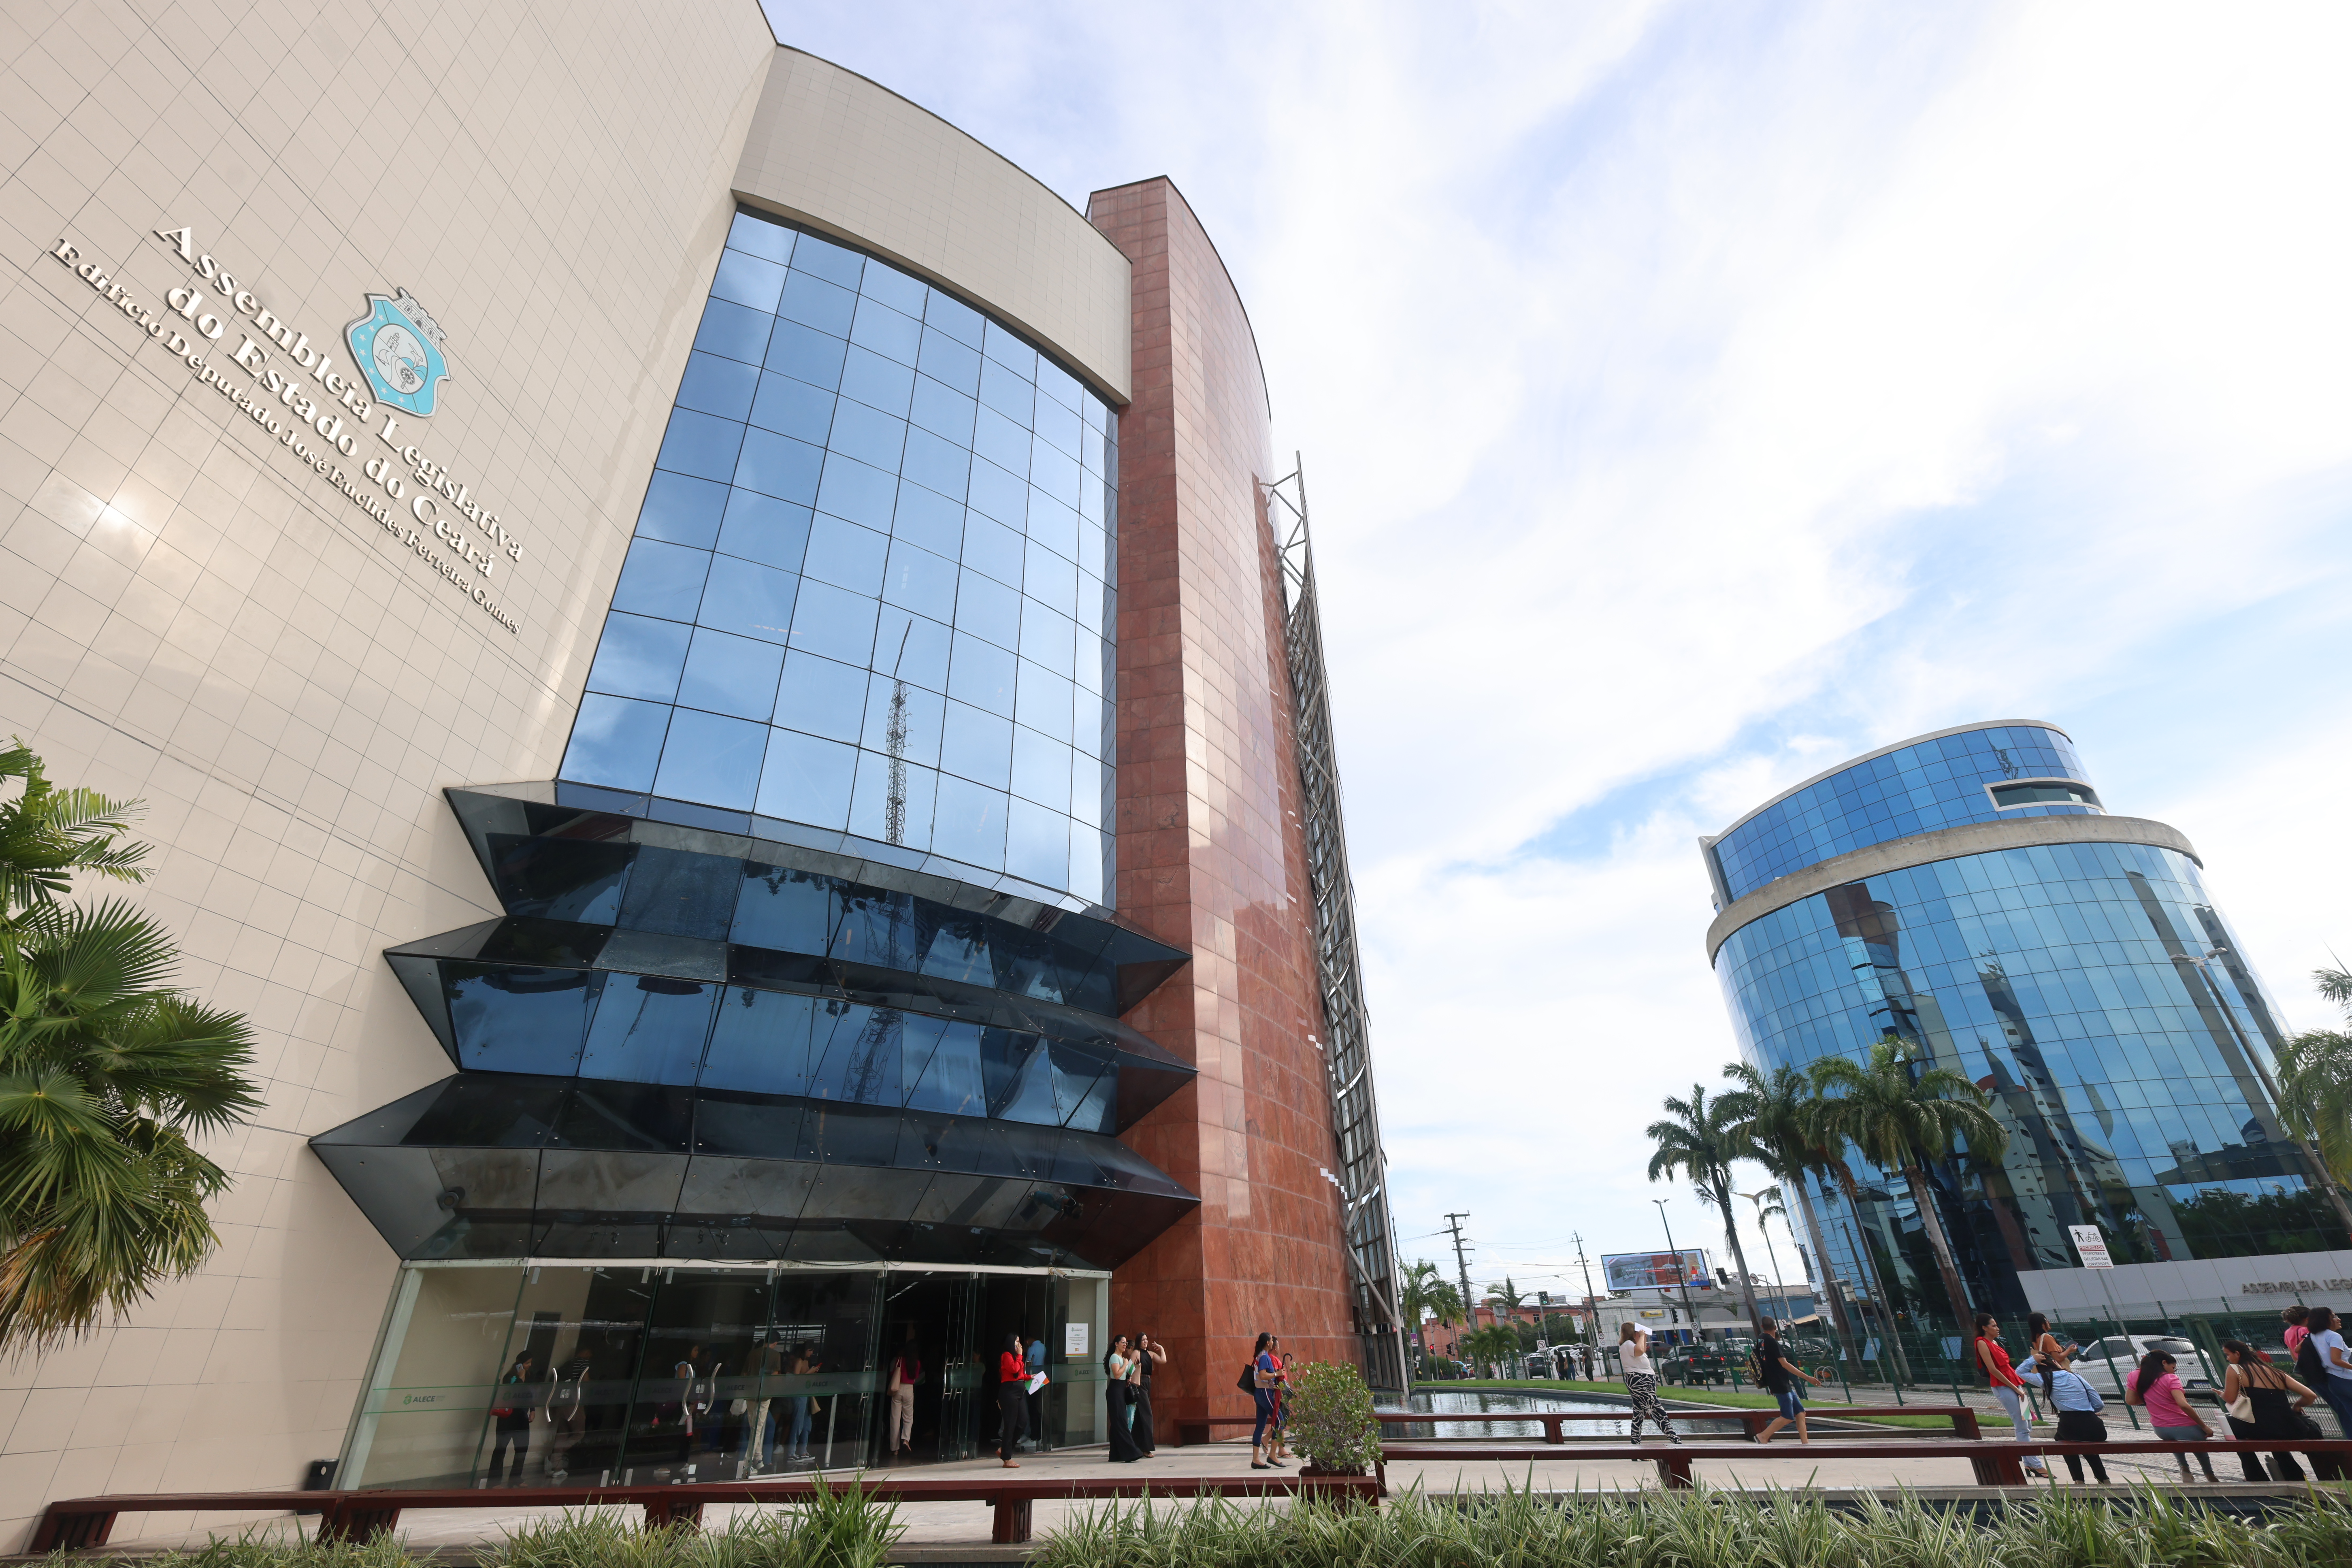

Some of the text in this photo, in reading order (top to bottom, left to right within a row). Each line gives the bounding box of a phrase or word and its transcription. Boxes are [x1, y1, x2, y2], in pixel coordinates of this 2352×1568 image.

[50, 239, 521, 634] Edifício Deputado José Euclides Ferreira Gomes
[153, 227, 523, 562] Assembleia Legislativa
[166, 288, 495, 577] do Estado do Ceará
[2242, 1280, 2324, 1293] ASSEMBLEIA
